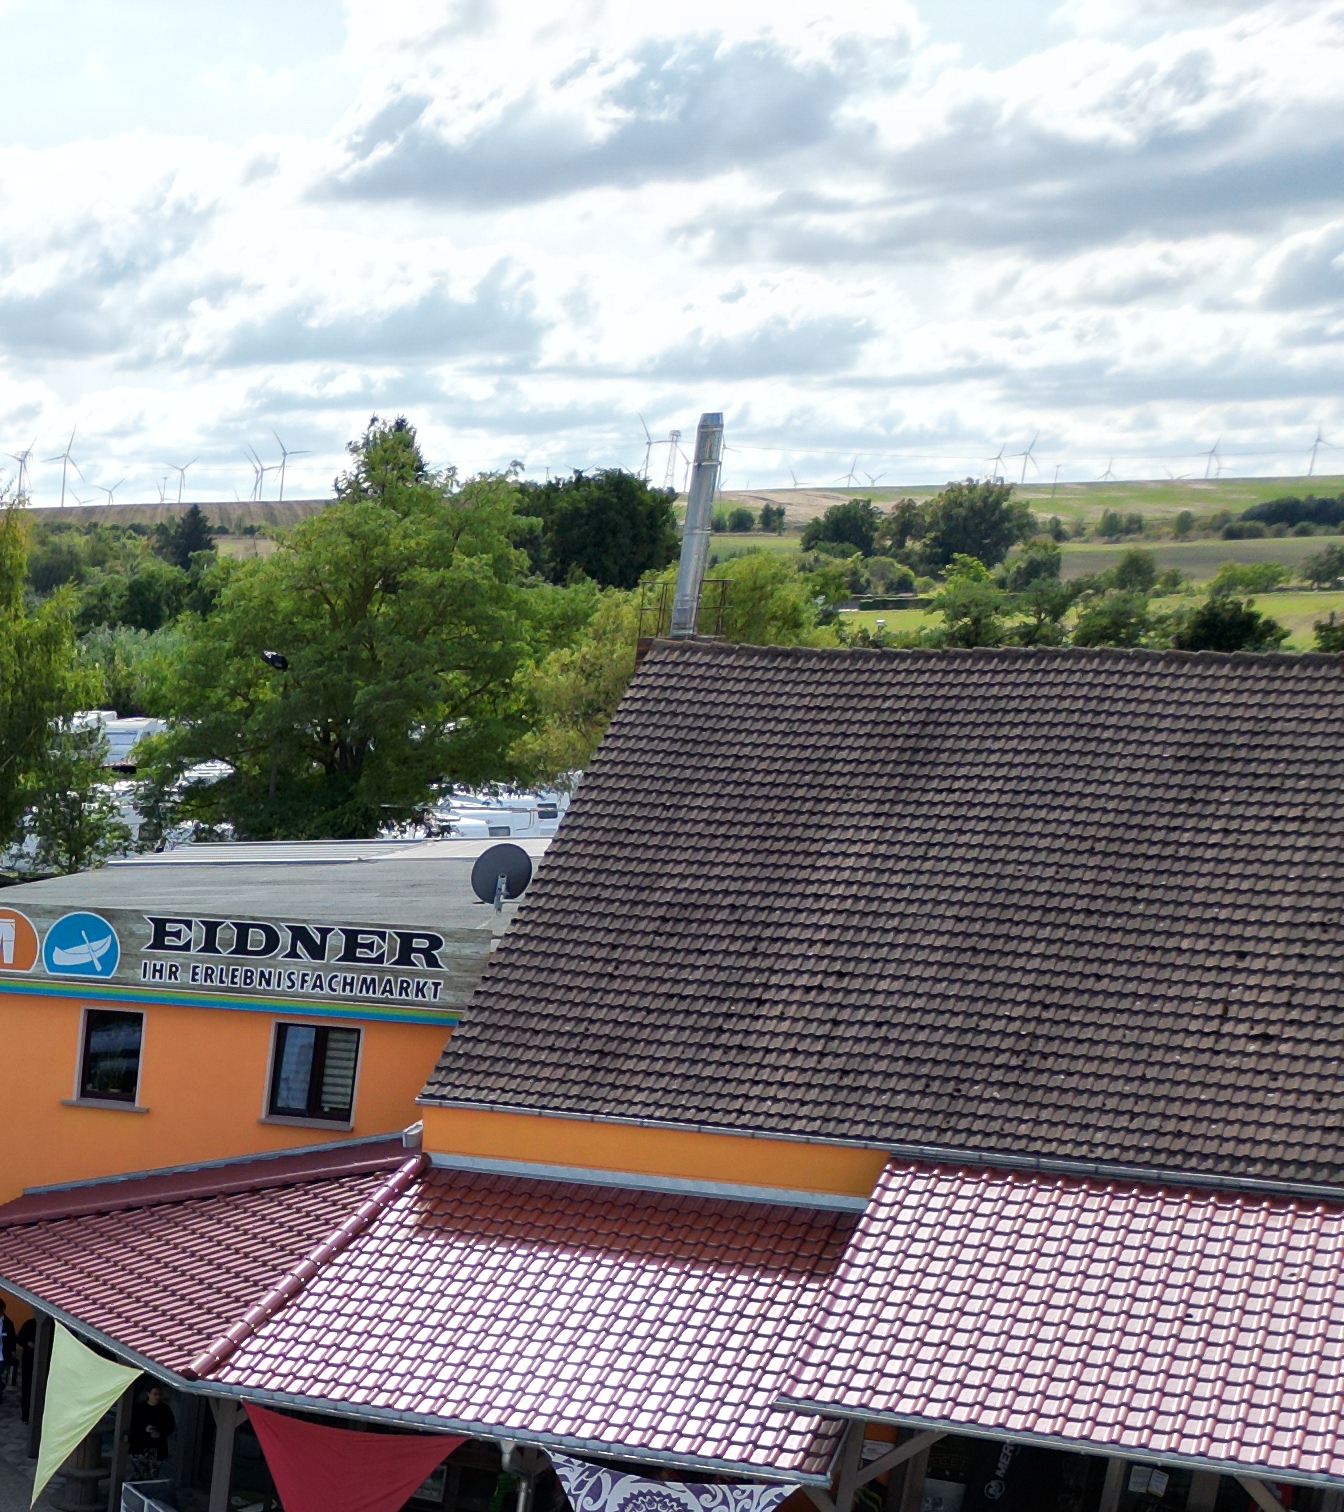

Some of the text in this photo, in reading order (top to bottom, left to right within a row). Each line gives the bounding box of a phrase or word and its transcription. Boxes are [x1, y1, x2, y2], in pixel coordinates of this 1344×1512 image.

[141, 915, 448, 971] EIDNER
[141, 961, 444, 1001] IHR ERLEBNISFACHMARKT
